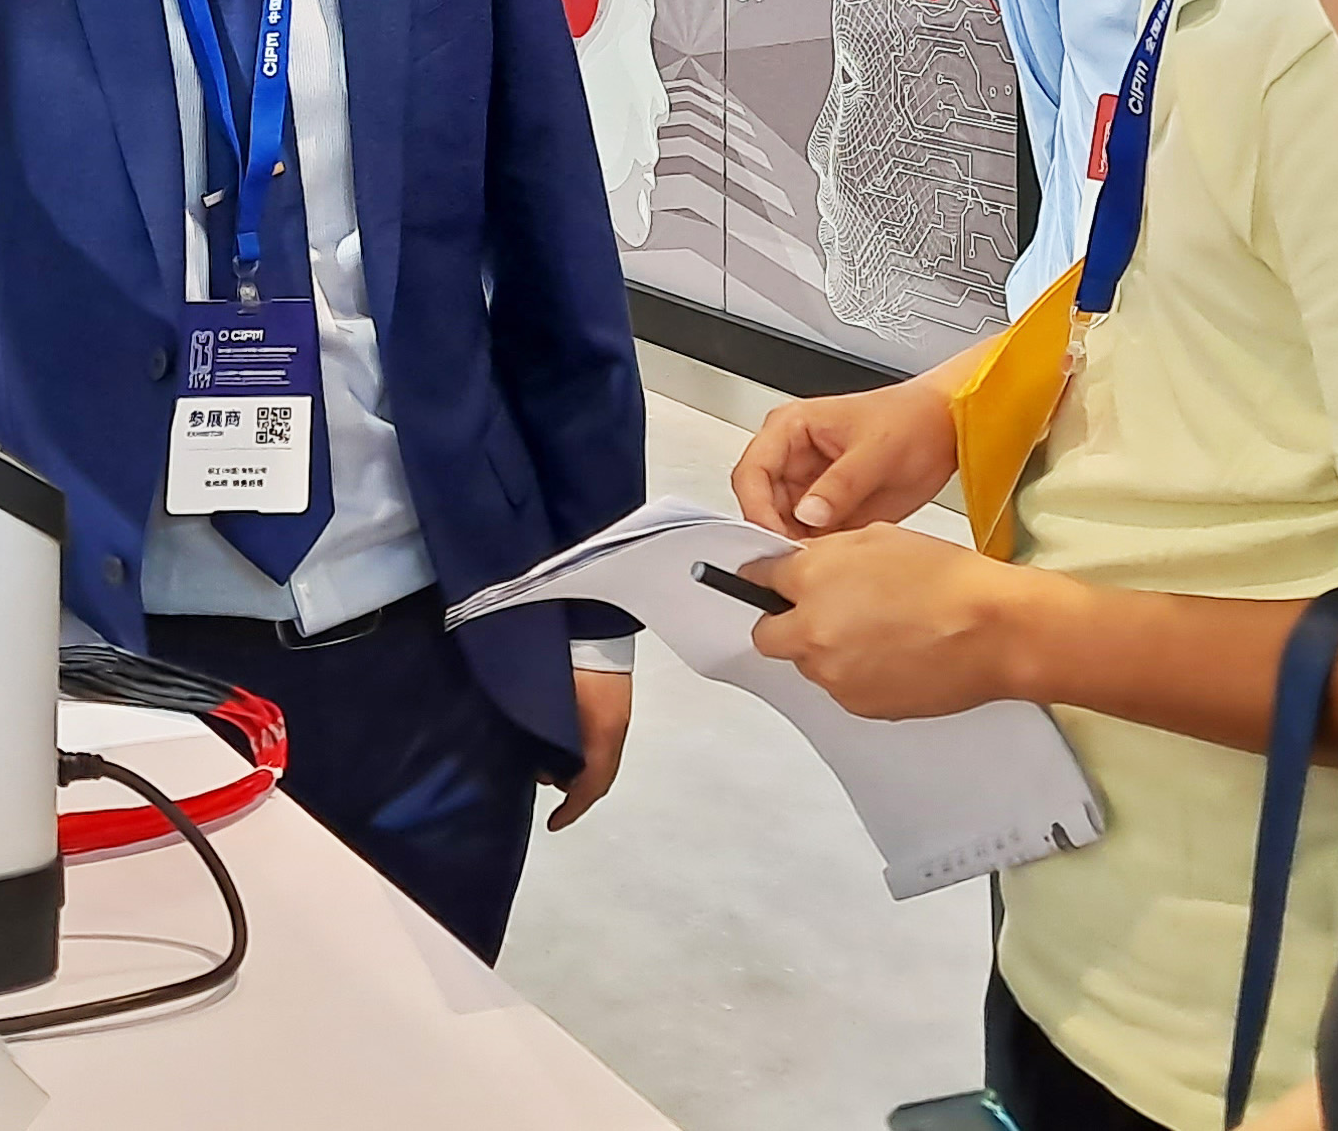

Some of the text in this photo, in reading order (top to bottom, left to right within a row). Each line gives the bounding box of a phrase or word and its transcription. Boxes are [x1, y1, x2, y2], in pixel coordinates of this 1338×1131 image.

[262, 30, 280, 77] CIPM
[1127, 59, 1149, 115] CIPM
[188, 409, 242, 428] 参展商
